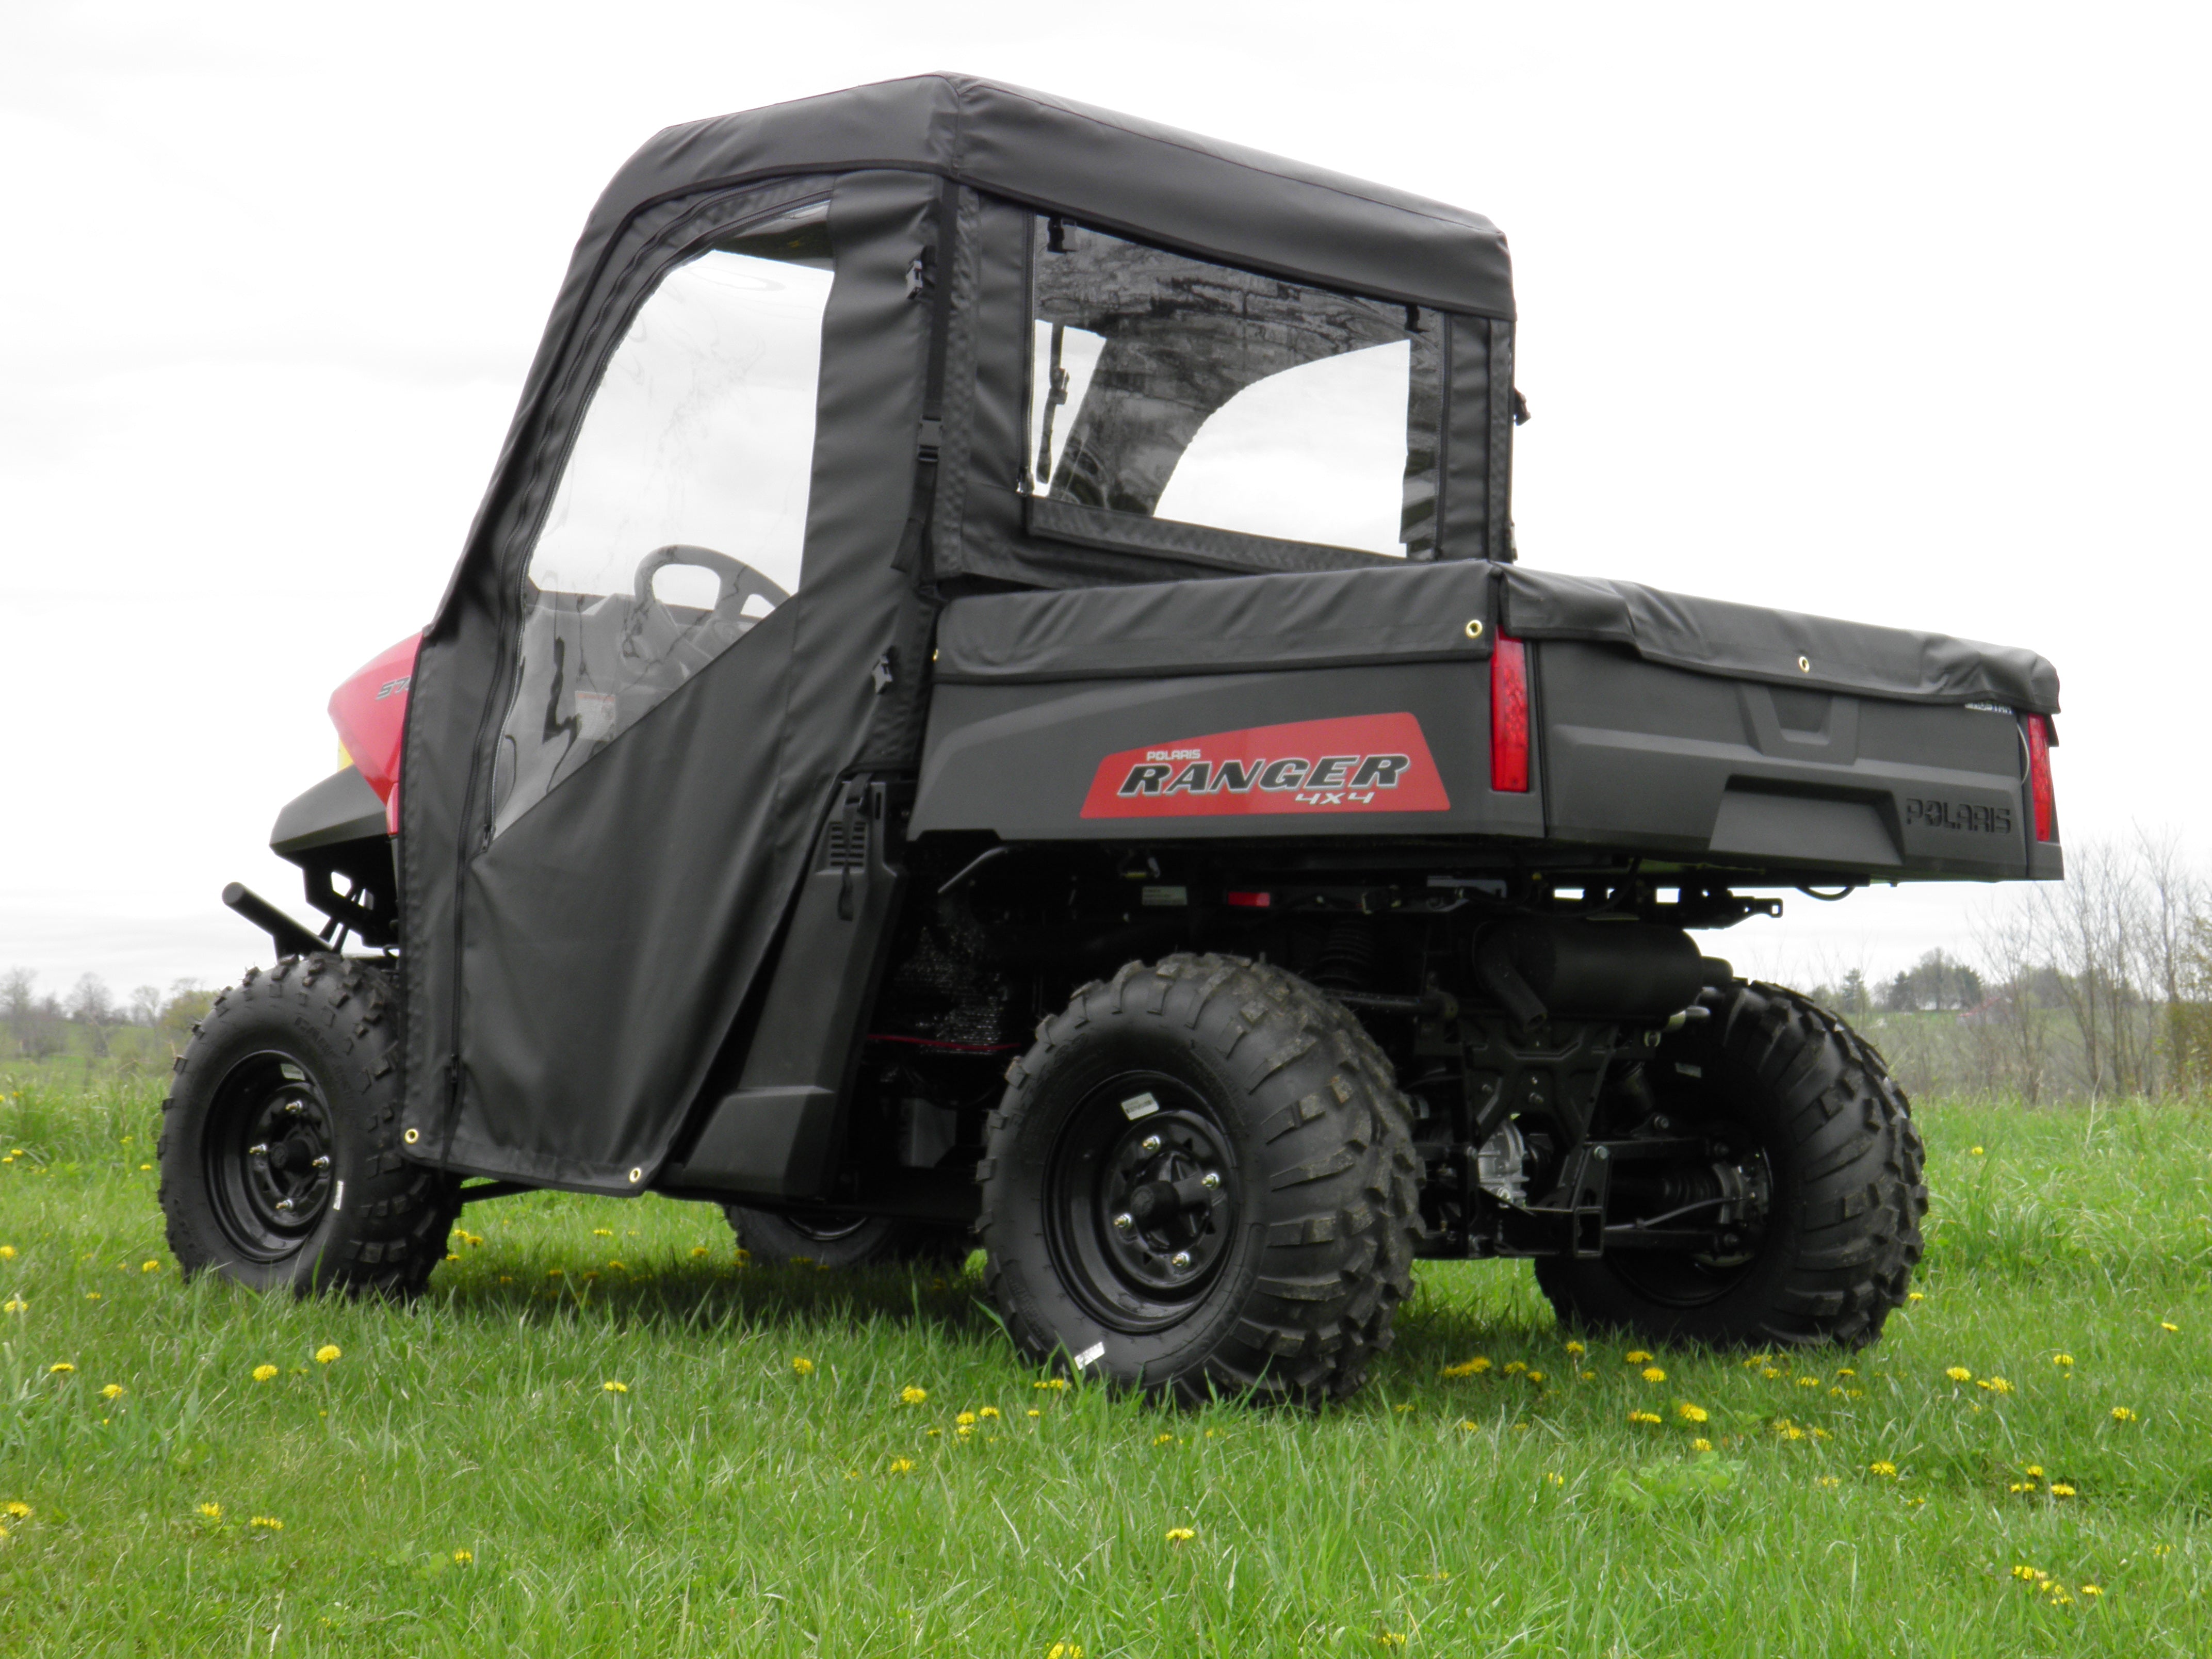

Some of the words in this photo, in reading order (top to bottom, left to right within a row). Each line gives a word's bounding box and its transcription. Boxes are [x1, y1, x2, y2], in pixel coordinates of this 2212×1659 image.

[376, 676, 411, 701] 57
[1146, 749, 1200, 761] POLARIS
[1117, 753, 1411, 798] RANGER
[1907, 798, 2011, 834] POLARIS
